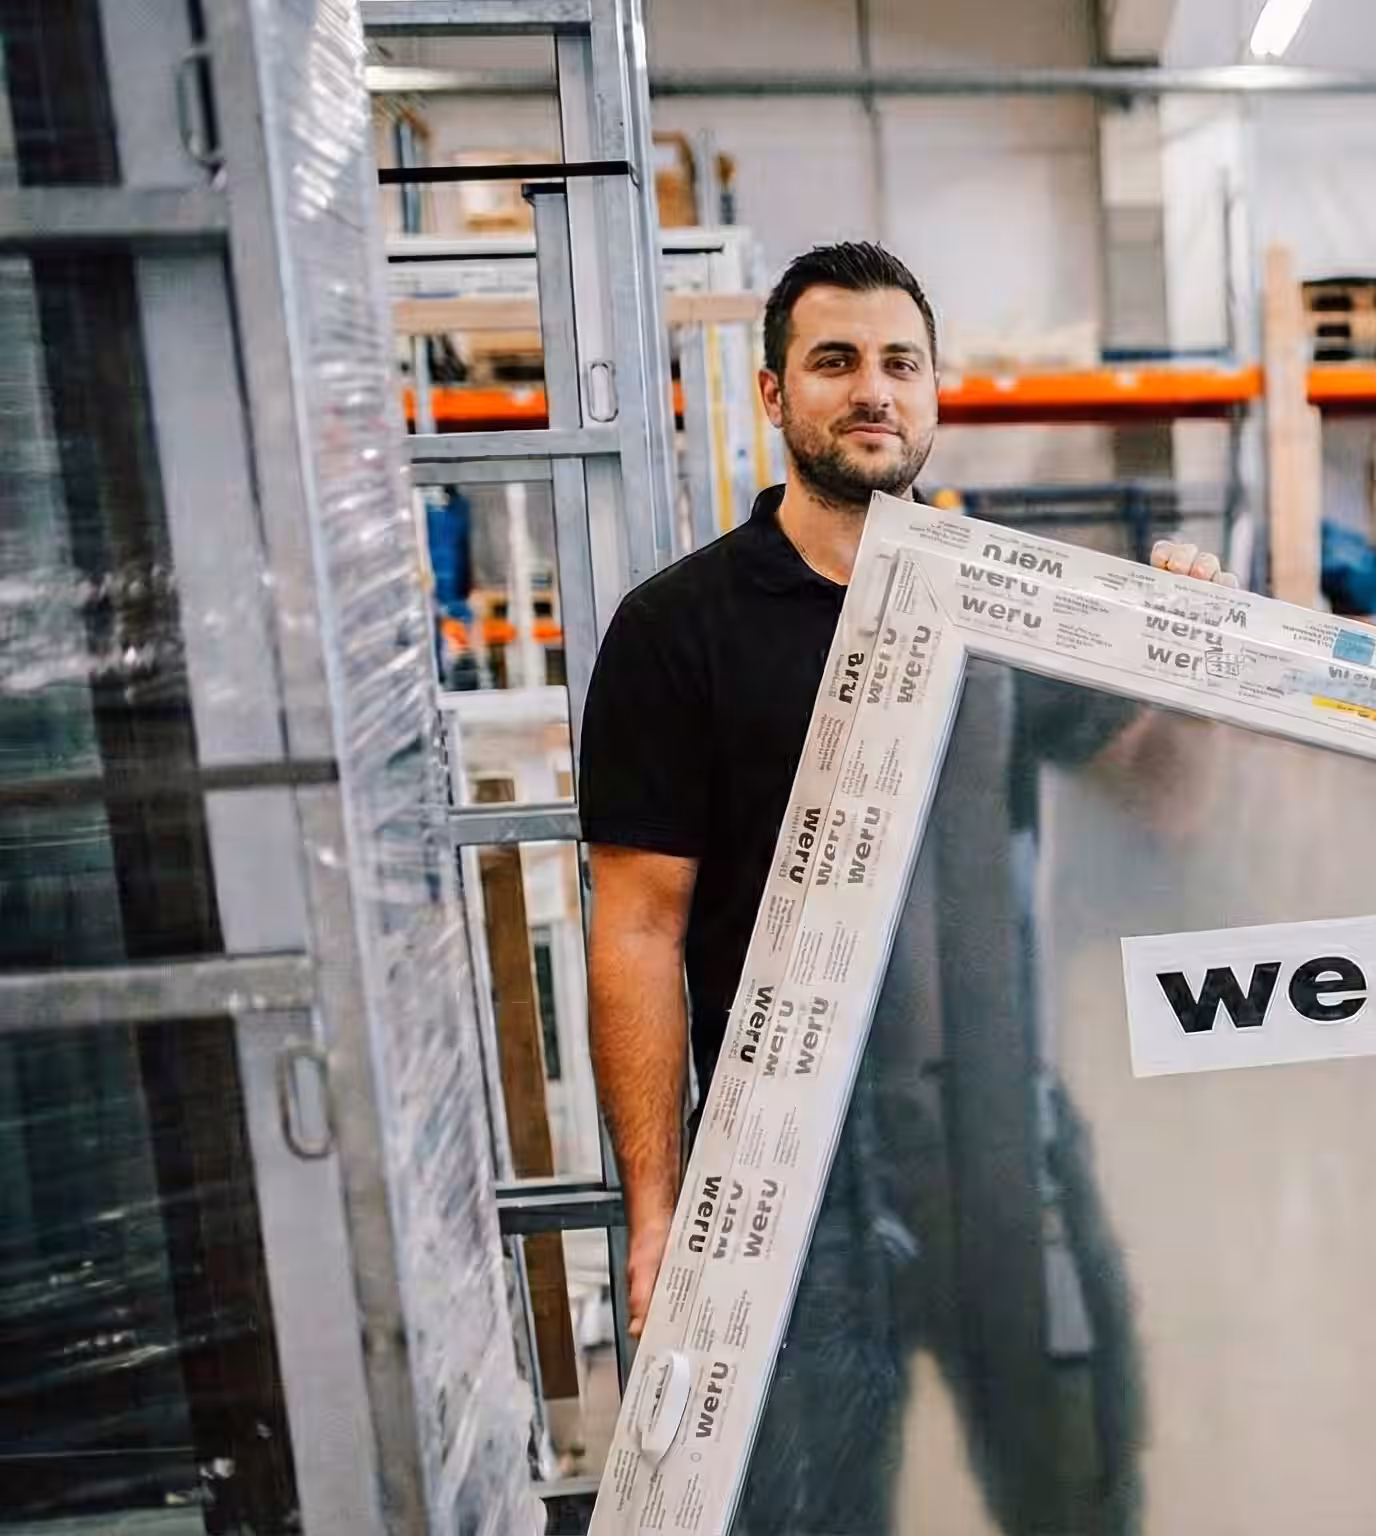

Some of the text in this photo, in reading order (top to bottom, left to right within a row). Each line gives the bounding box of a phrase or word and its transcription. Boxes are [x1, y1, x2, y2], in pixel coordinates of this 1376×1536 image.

[959, 562, 1040, 597] weru
[982, 544, 1063, 579] weru
[961, 594, 1042, 629] weru
[897, 625, 931, 703] weru
[1147, 644, 1203, 672] wer
[789, 807, 822, 884] weru
[816, 810, 846, 885] weru
[848, 806, 881, 884] weru
[740, 985, 774, 1064] weru
[763, 1000, 794, 1076] weru
[795, 997, 829, 1074] weru
[688, 1176, 722, 1252] weru
[696, 1361, 729, 1438] weru
